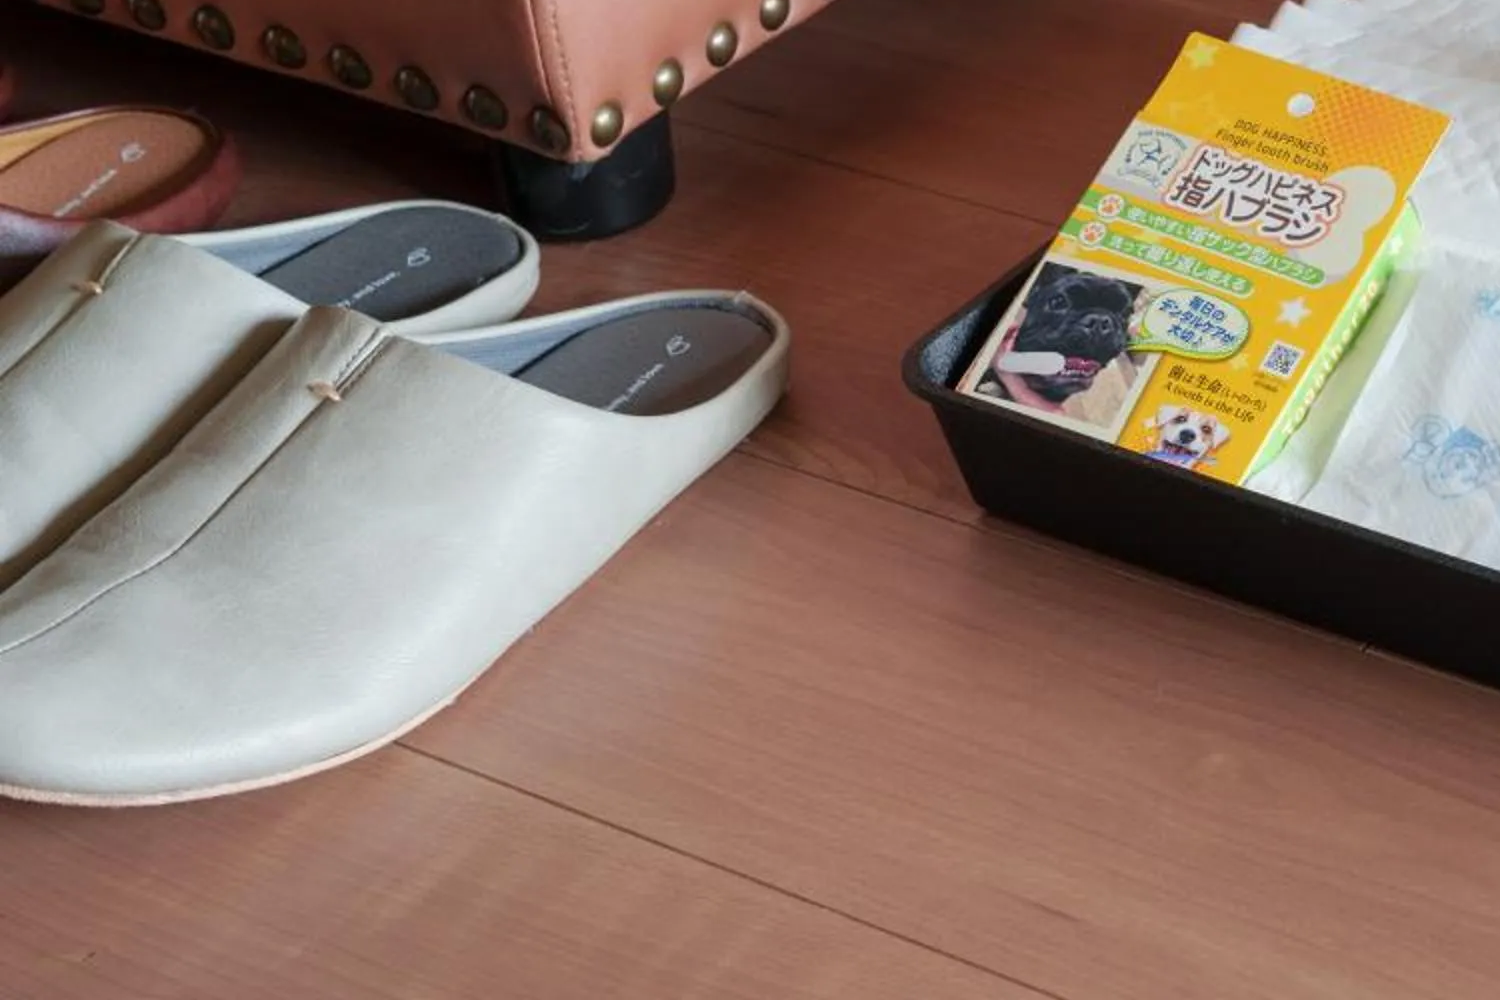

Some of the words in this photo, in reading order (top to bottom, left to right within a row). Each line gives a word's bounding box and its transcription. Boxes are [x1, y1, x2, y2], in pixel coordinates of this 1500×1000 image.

[1233, 119, 1260, 134] DOG
[1261, 127, 1329, 157] HAPPINESS
[1255, 141, 1291, 161] tooth
[1292, 153, 1329, 173] brush
[1193, 149, 1337, 217] ドッグハピネス
[1170, 171, 1322, 241] 指ハブラシ
[1215, 400, 1234, 414] the
[1233, 406, 1256, 423] Life
